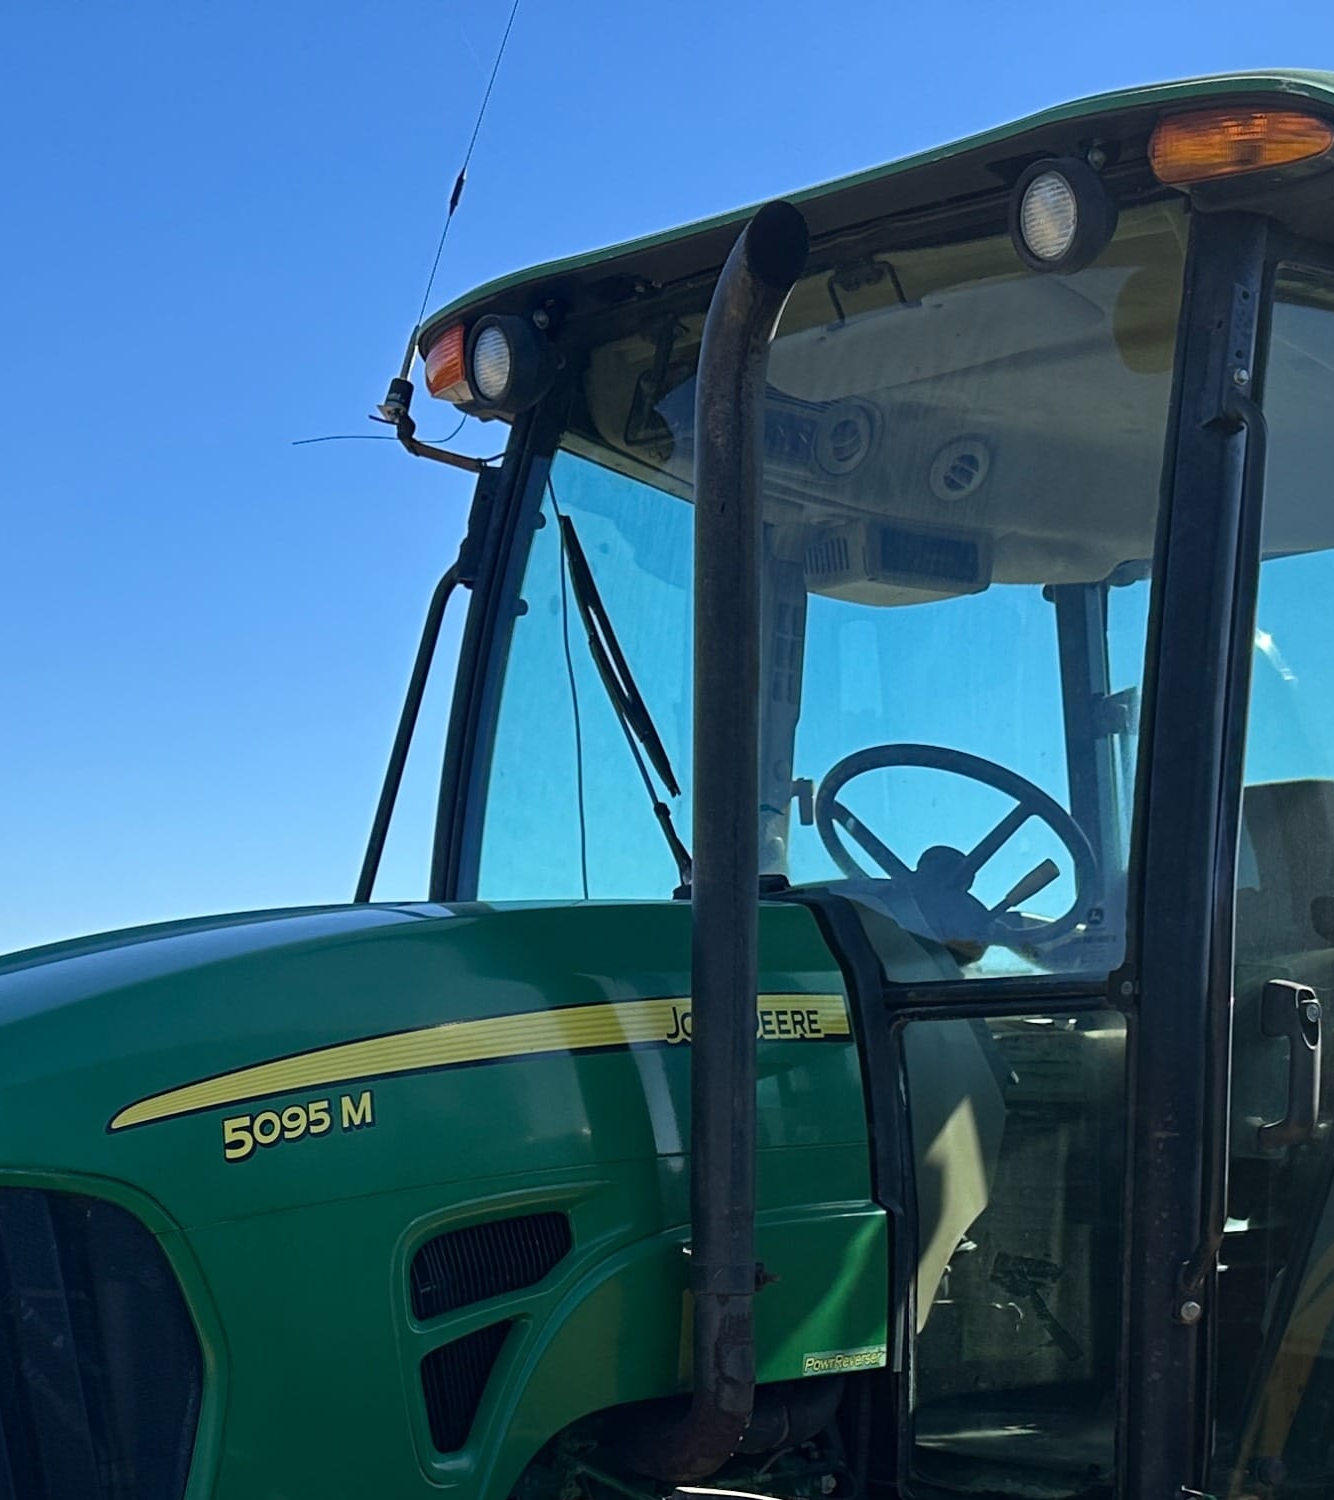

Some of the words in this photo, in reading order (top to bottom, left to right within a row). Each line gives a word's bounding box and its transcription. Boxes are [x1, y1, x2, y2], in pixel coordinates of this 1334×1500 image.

[756, 1009, 822, 1035] EERE
[223, 1100, 332, 1160] 5095
[341, 1091, 373, 1128] M
